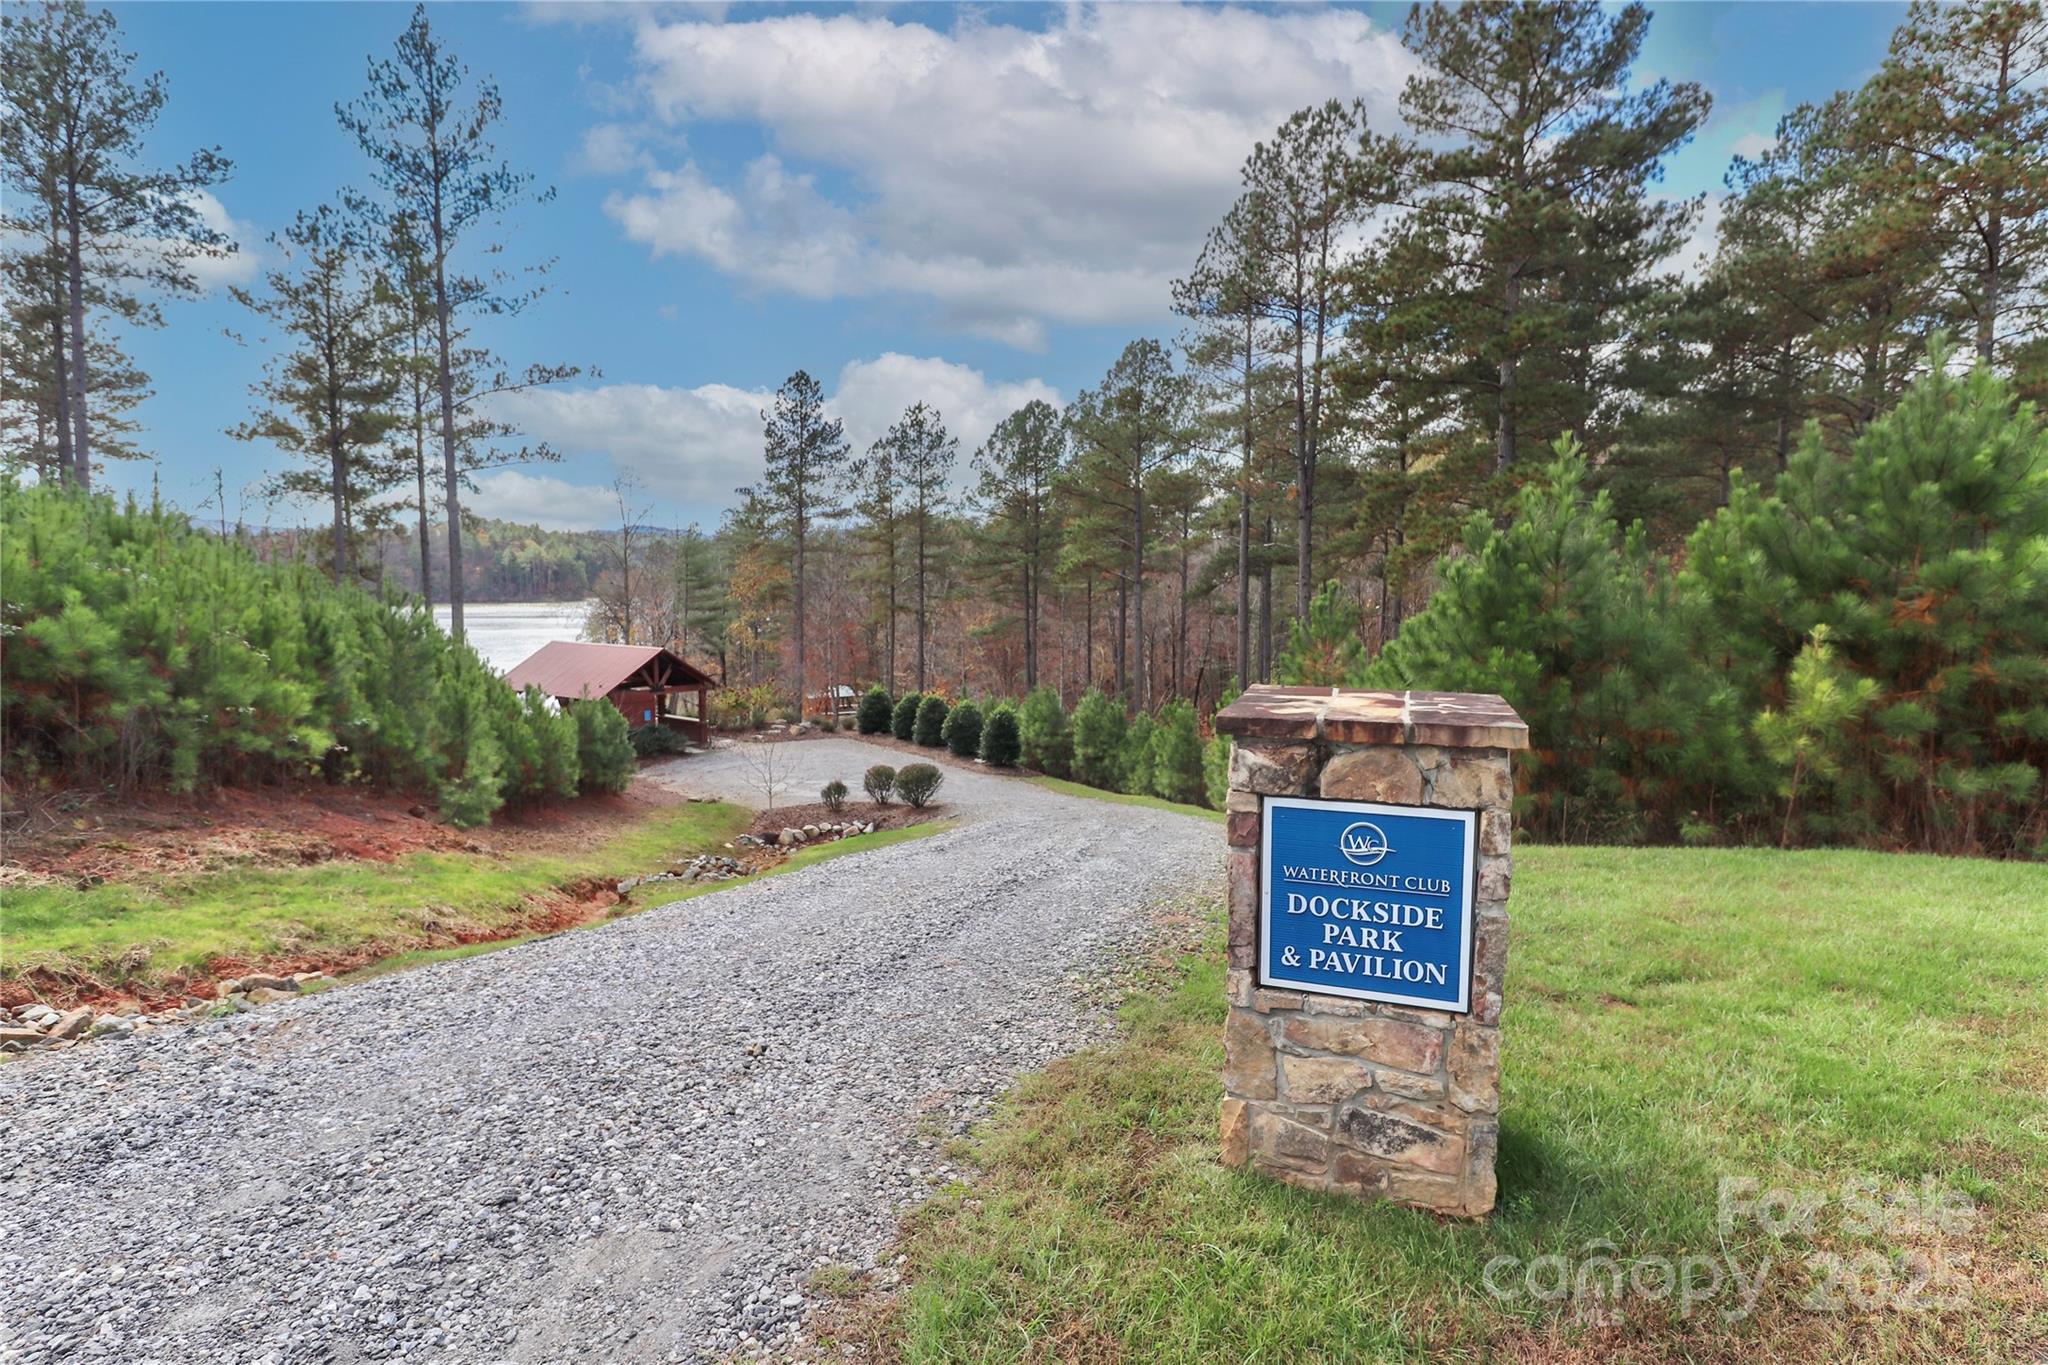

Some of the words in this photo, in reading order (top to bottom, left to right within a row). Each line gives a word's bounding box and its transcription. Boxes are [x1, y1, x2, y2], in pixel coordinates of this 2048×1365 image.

[1283, 865, 1400, 888] WATERFRONT
[1405, 876, 1451, 893] CLUB
[1287, 893, 1444, 930] DOCKSIDE
[1323, 923, 1404, 952] PARK
[1281, 945, 1301, 967] &
[1308, 948, 1448, 985] PAVILION
